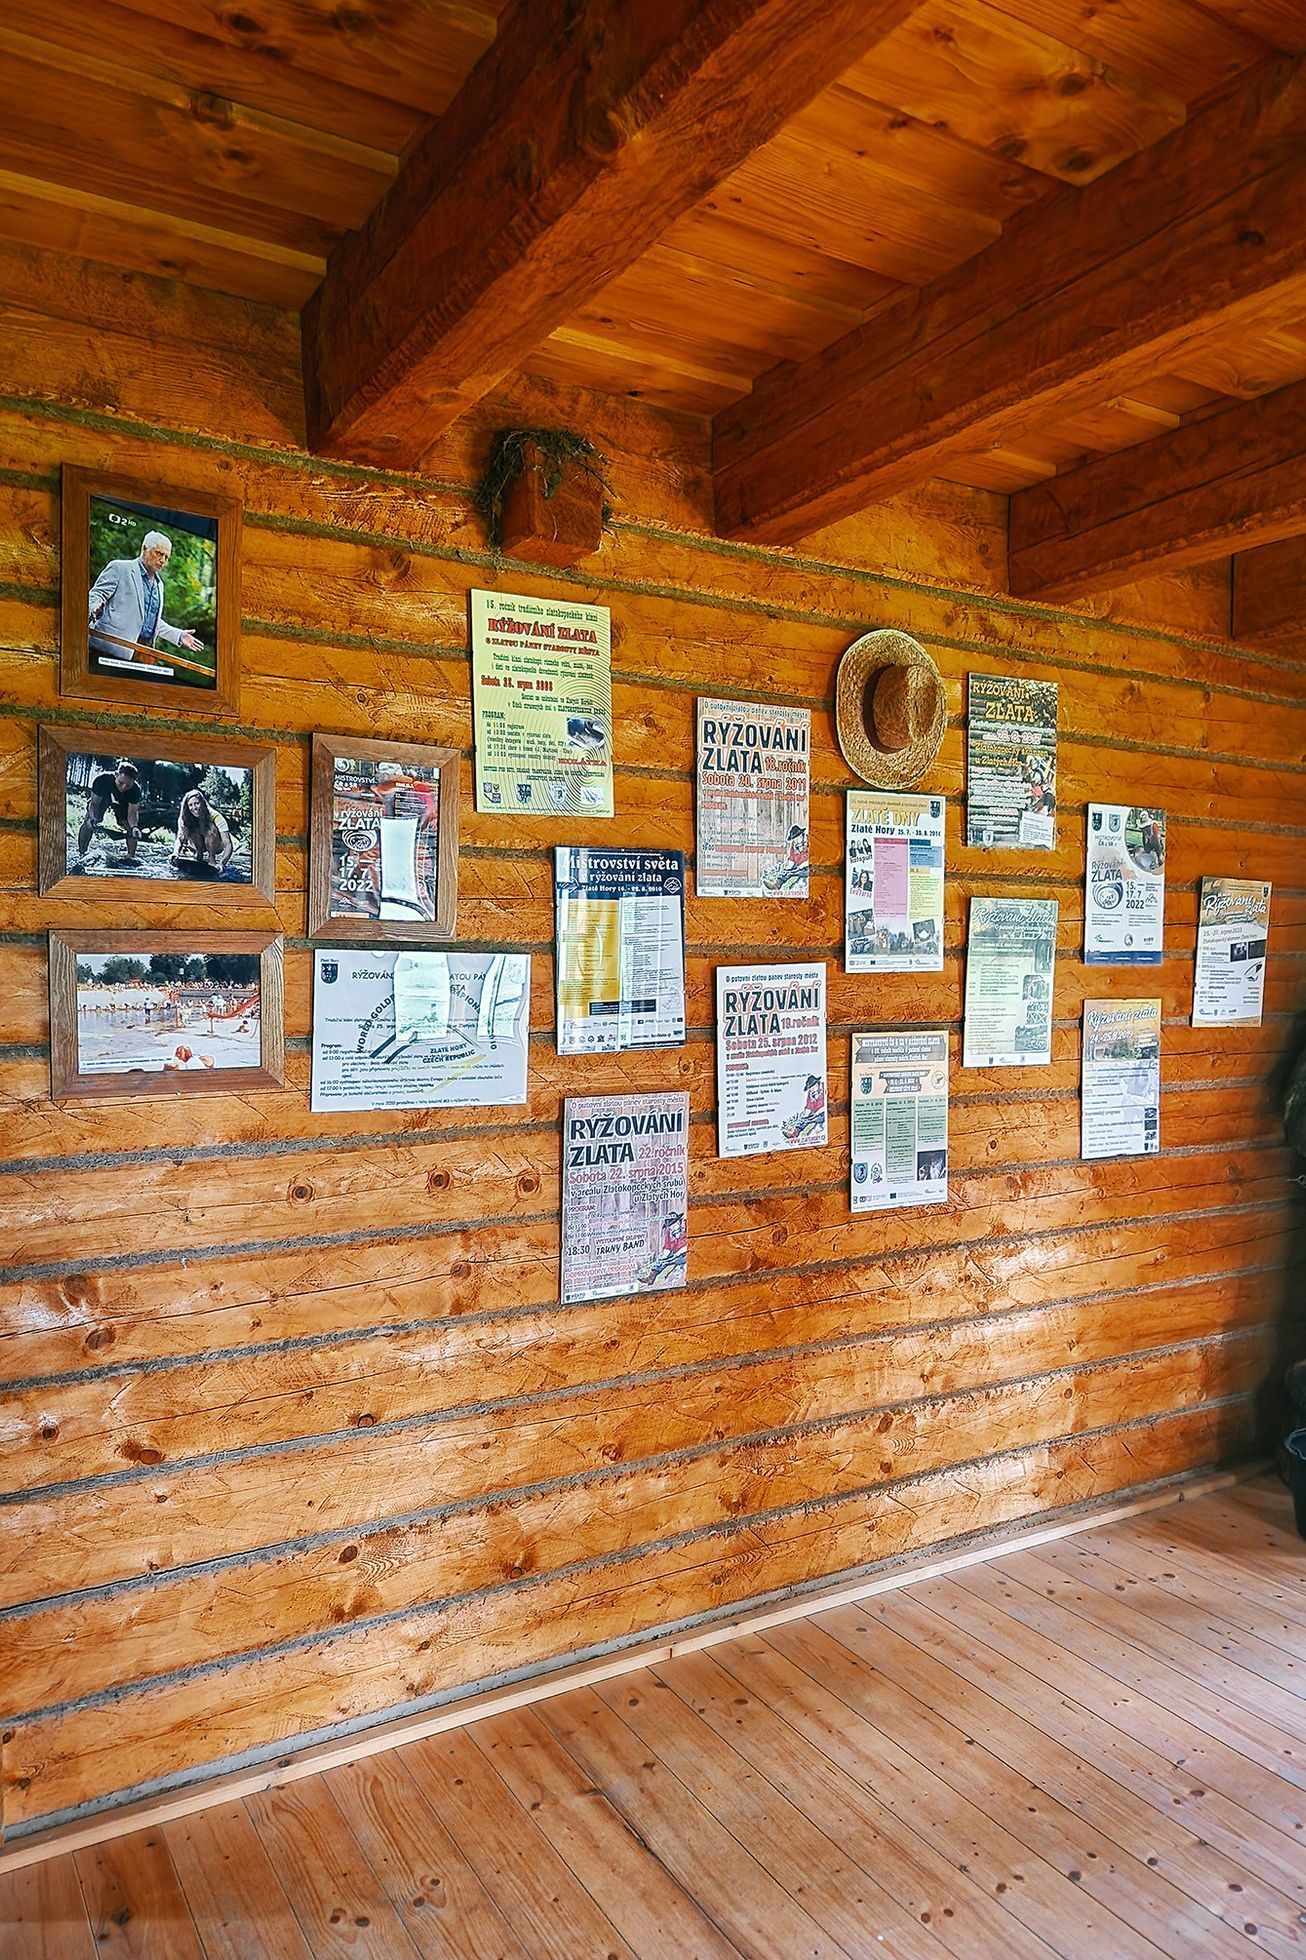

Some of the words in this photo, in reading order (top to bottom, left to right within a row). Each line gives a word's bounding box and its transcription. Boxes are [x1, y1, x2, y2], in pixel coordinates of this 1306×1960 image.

[488, 617, 555, 636] RÝŽOVÁNÍ
[558, 626, 597, 643] ZLATA
[973, 680, 1025, 698] RÝŽOVÁNÍ
[985, 701, 1035, 722] ZLATA
[704, 716, 809, 752] RÝŽOVÁNÍ
[703, 747, 763, 774] ZLATA
[702, 771, 735, 786] Sobota
[738, 775, 753, 787] 20.
[757, 777, 782, 790] srpna
[786, 778, 806, 791] 2011
[341, 808, 383, 818] rýžování
[851, 807, 889, 825] ZLATÉ
[339, 818, 380, 830] ZLATA
[851, 824, 873, 834] Zlaté
[875, 825, 895, 835] Hory
[339, 856, 357, 867] 15.
[645, 856, 679, 870] světa
[339, 868, 357, 878] 17.
[590, 872, 635, 883] rýžování
[638, 872, 662, 882] zlata
[1091, 869, 1122, 882] ZLATA
[339, 880, 373, 892] 2022
[1126, 900, 1144, 909] 2022
[352, 969, 394, 979] RÝŽOVÁN
[726, 982, 821, 1013] RÝŽOVÁNÍ
[726, 1014, 781, 1037] ZLATA
[430, 1046, 449, 1054] ZLATÉ
[726, 1039, 757, 1051] Sobota
[798, 1034, 818, 1045] 2012
[570, 1108, 684, 1140] RÝŽOVÁNÍ
[569, 1142, 635, 1168] ZLATA
[569, 1171, 606, 1184] Sobota
[610, 1167, 626, 1180] 22.
[629, 1166, 656, 1181] srpna
[660, 1162, 684, 1175] 2015
[568, 1245, 590, 1256] 18:30
[623, 1240, 645, 1252] BAND
